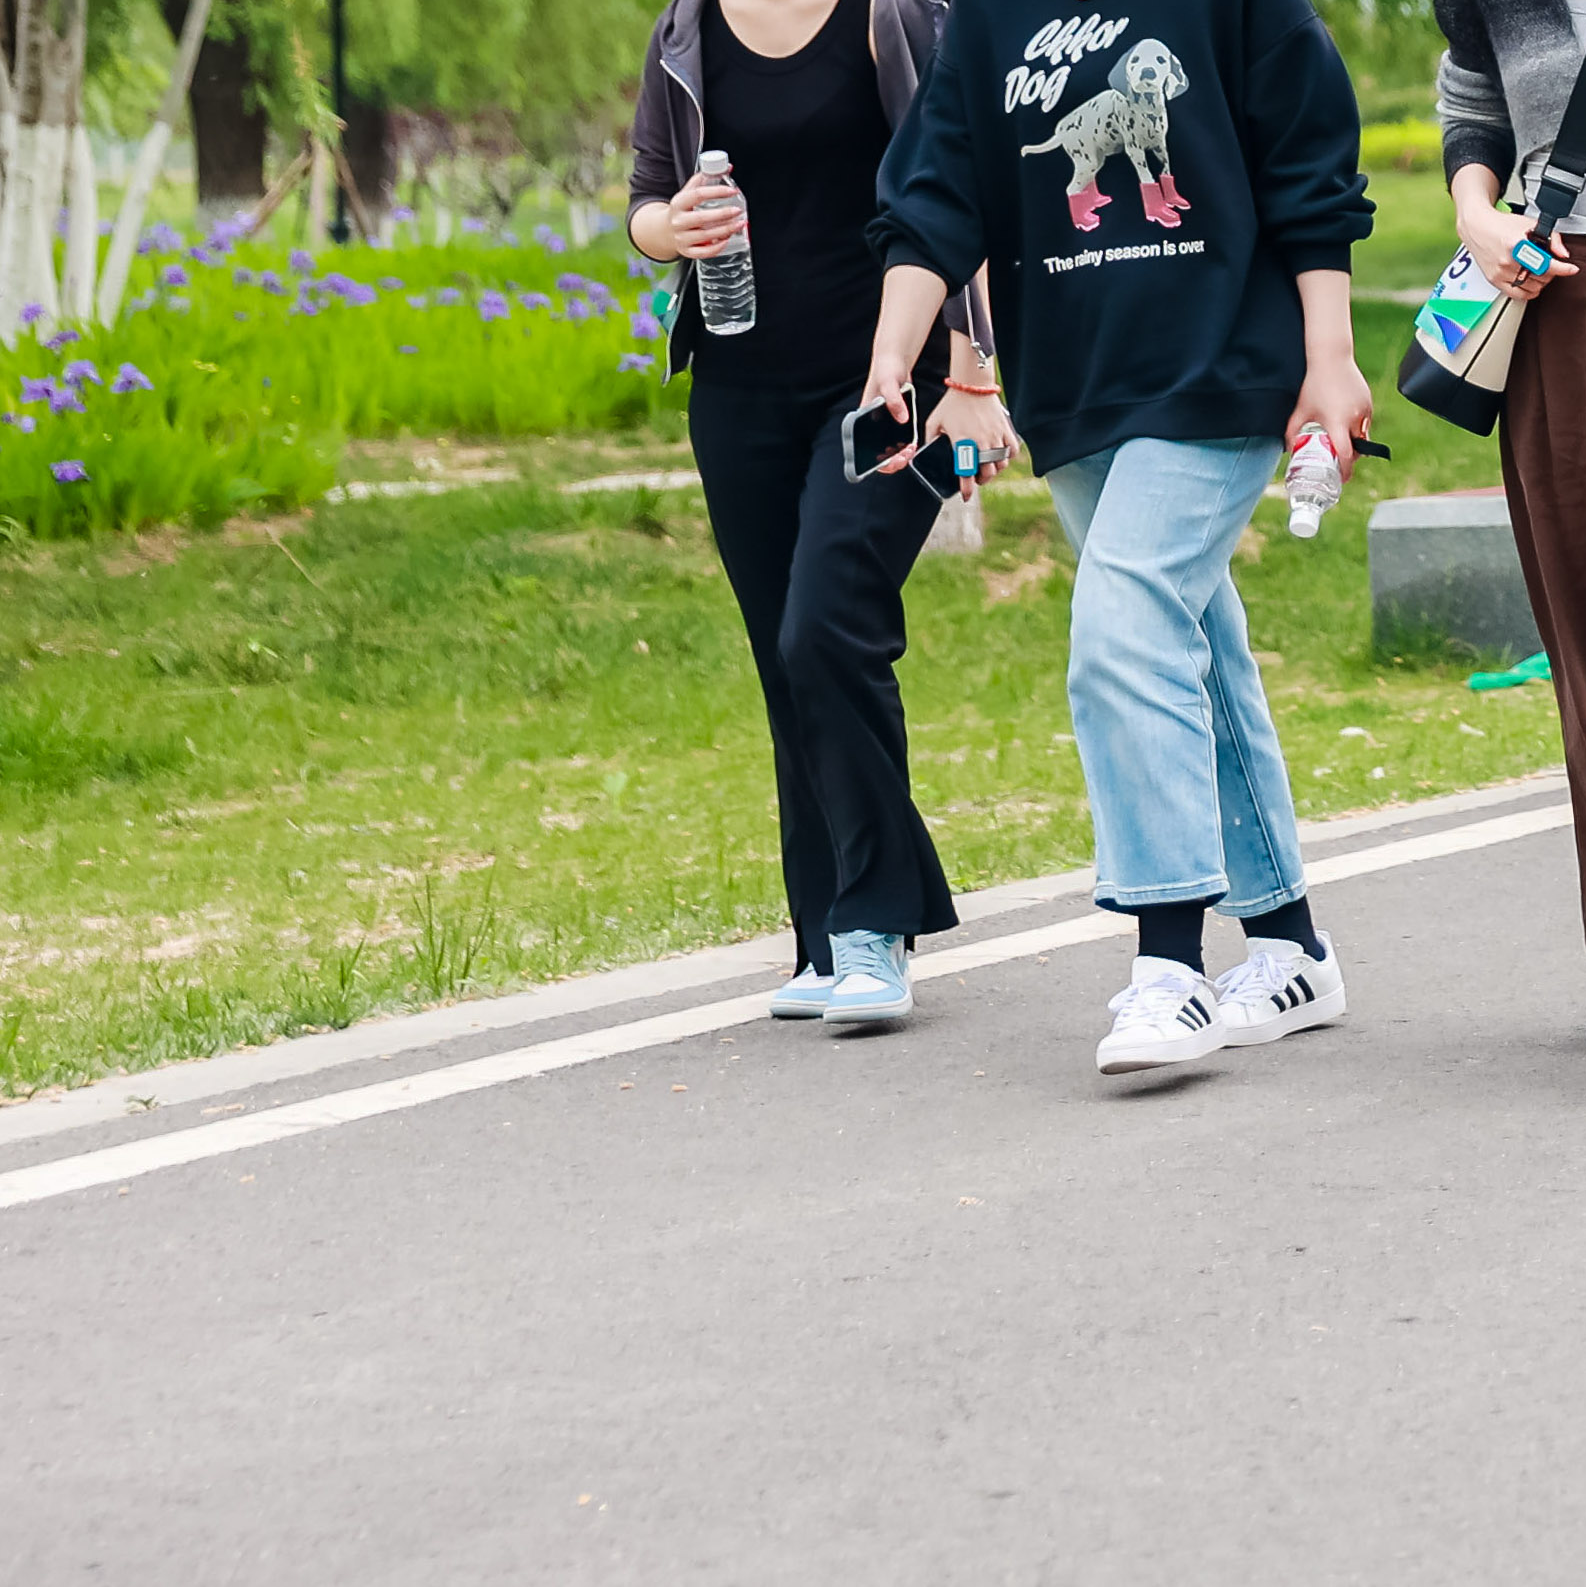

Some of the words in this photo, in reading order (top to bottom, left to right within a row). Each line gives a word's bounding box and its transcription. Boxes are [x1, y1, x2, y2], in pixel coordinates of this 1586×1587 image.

[1043, 256, 1074, 274] The
[1075, 249, 1104, 267] rainy
[1105, 243, 1161, 262] season
[1163, 240, 1177, 256] is
[1178, 240, 1205, 255] over
